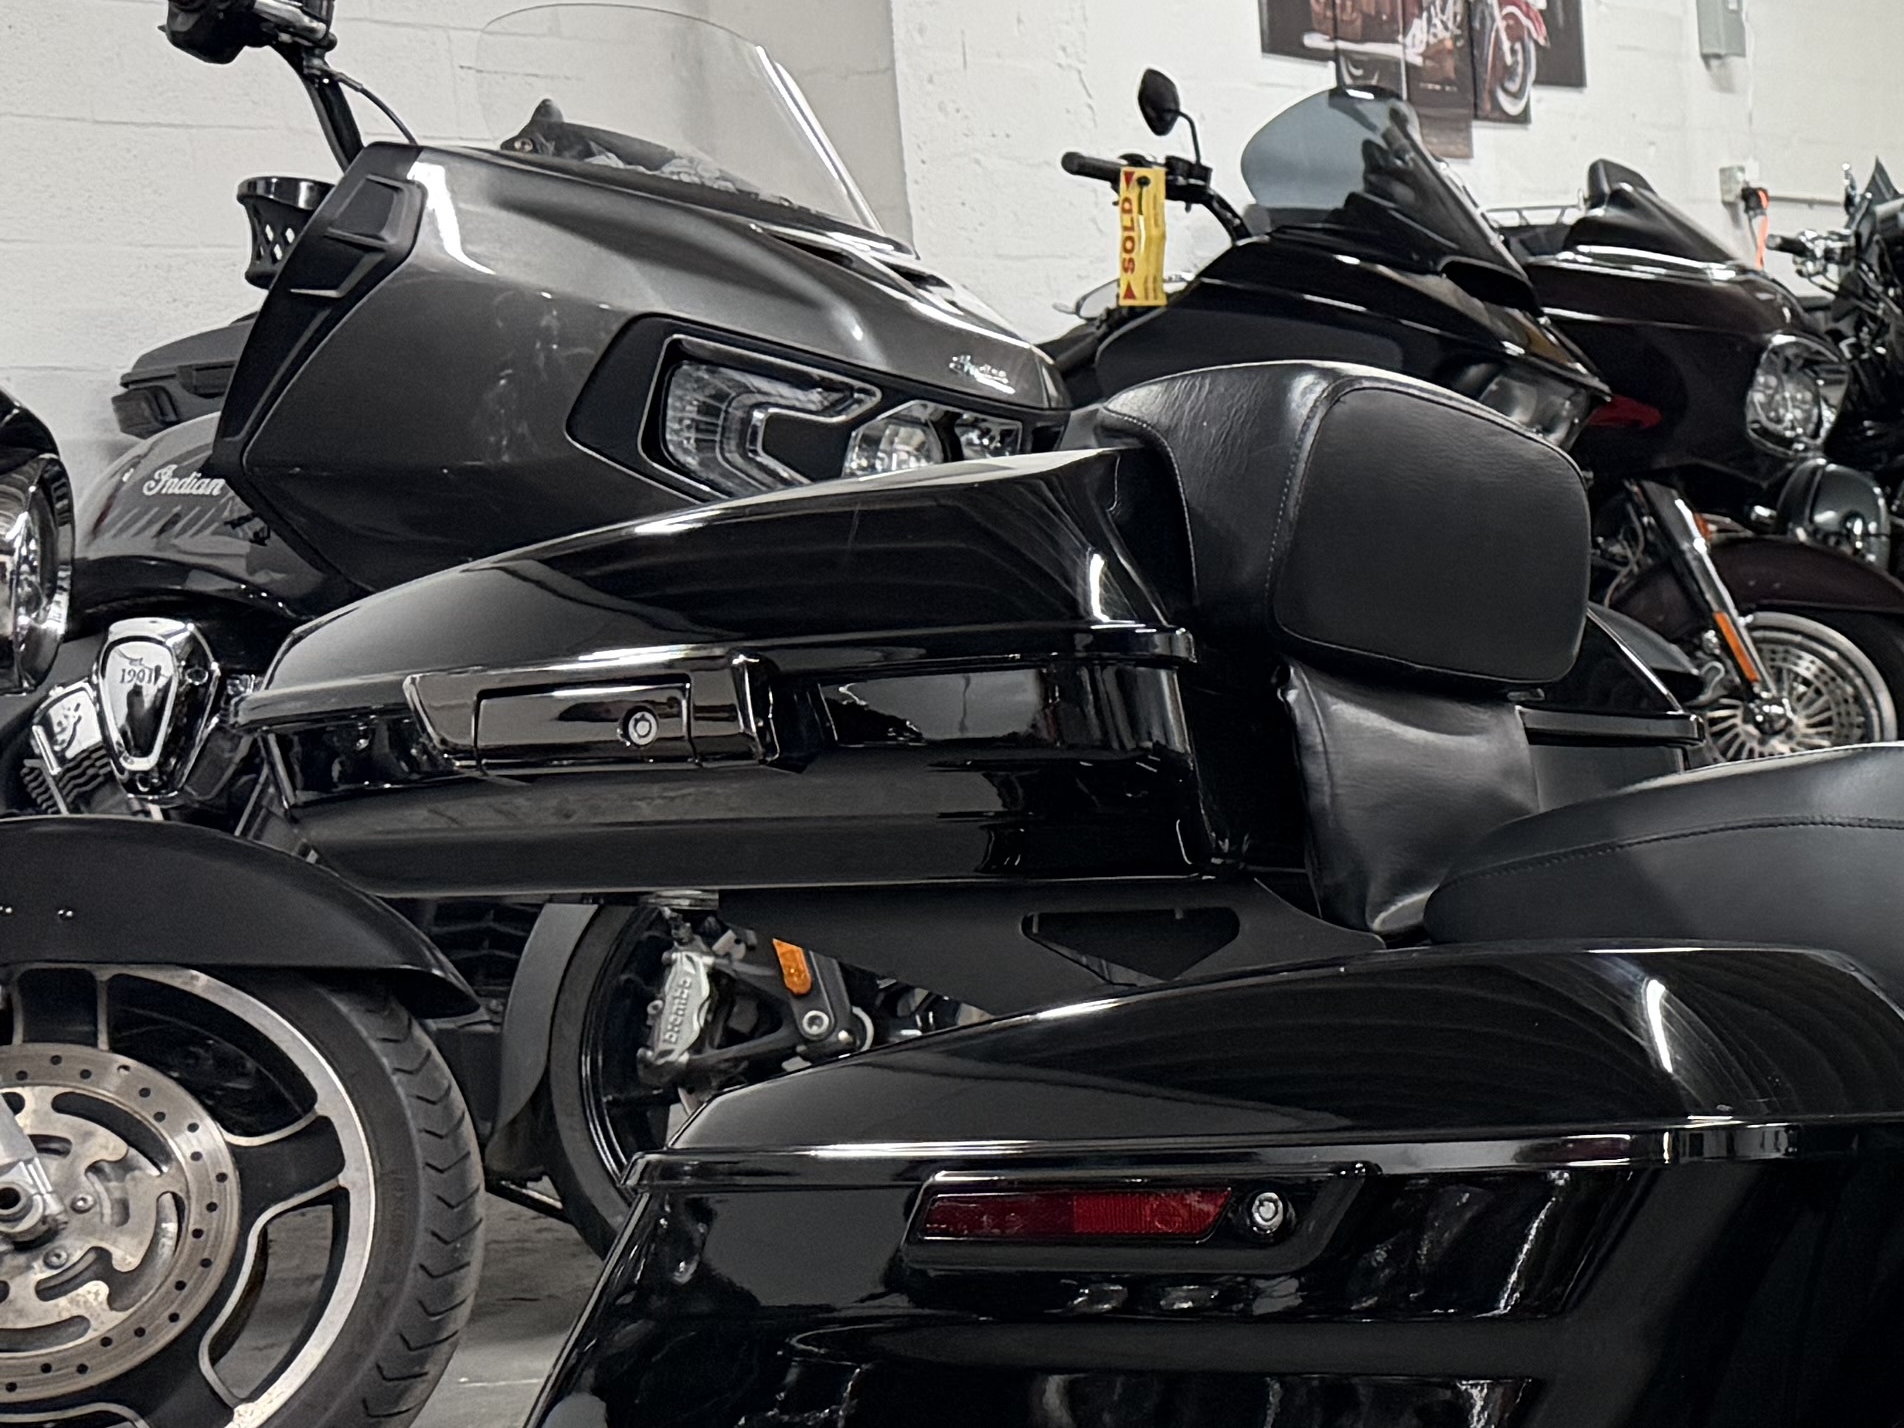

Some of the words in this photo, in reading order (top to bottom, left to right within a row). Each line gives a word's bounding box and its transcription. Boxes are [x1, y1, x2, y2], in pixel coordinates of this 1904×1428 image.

[1121, 196, 1136, 275] SOLD
[142, 464, 226, 496] Indian
[120, 668, 154, 685] 1901
